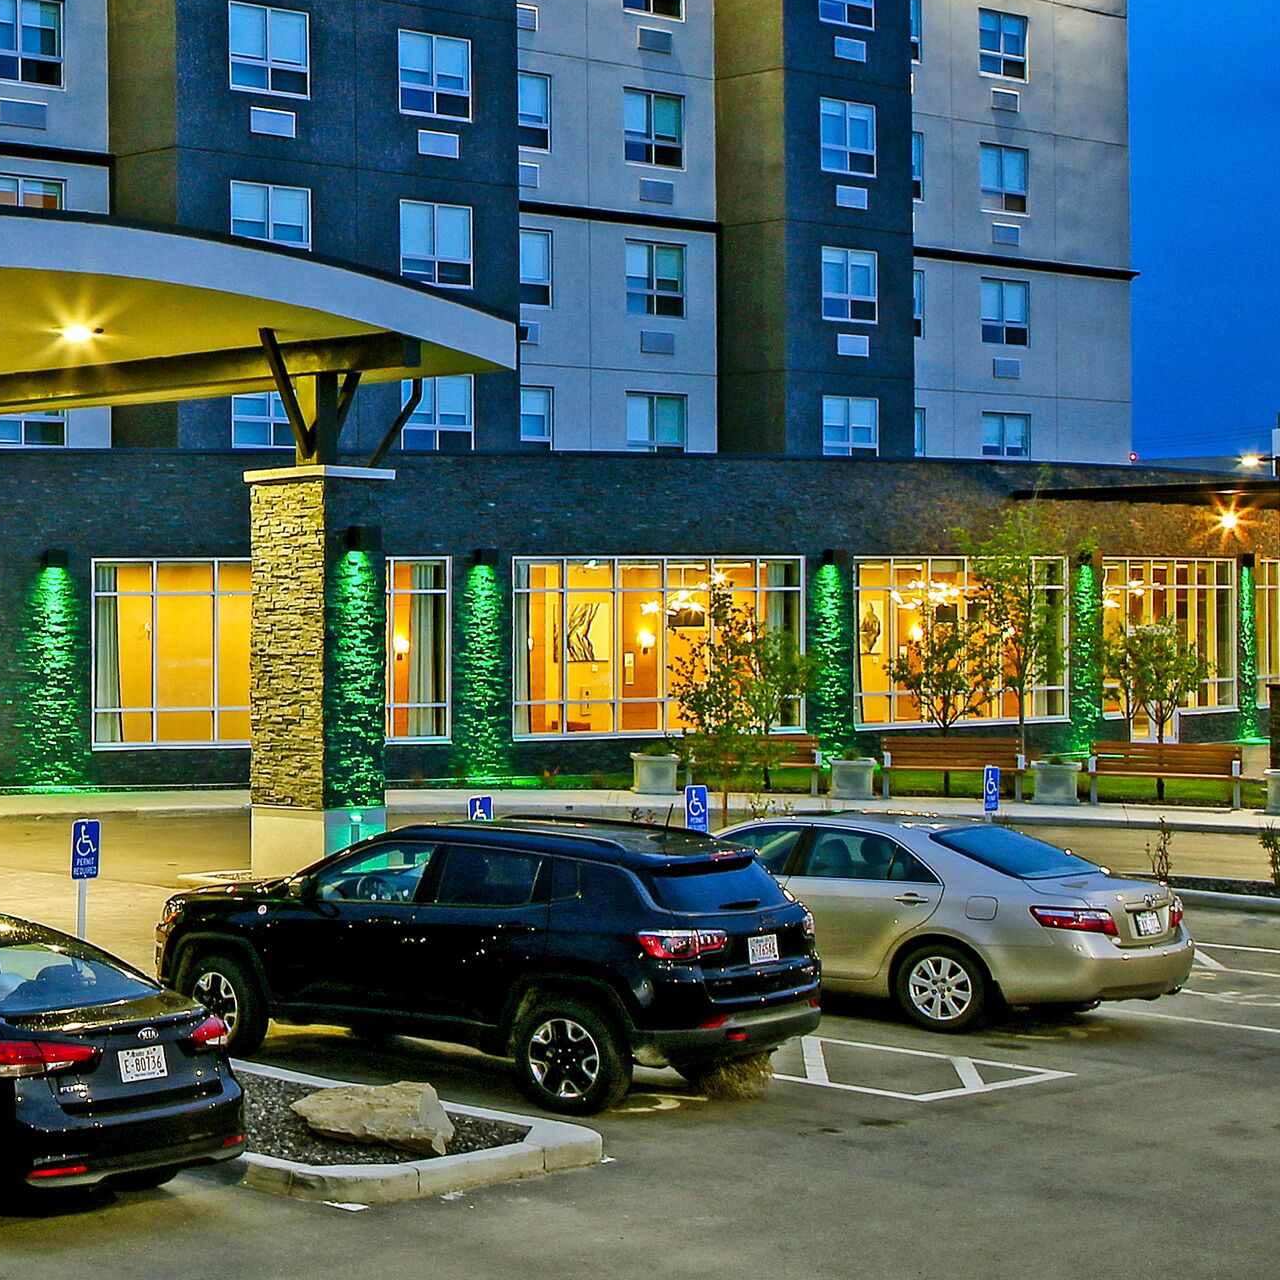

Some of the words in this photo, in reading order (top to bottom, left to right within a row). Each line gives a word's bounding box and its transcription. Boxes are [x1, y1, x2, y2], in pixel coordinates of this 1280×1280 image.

[76, 857, 95, 867] PERMIT
[142, 1030, 158, 1040] KIA
[124, 1055, 163, 1074] E-80736
